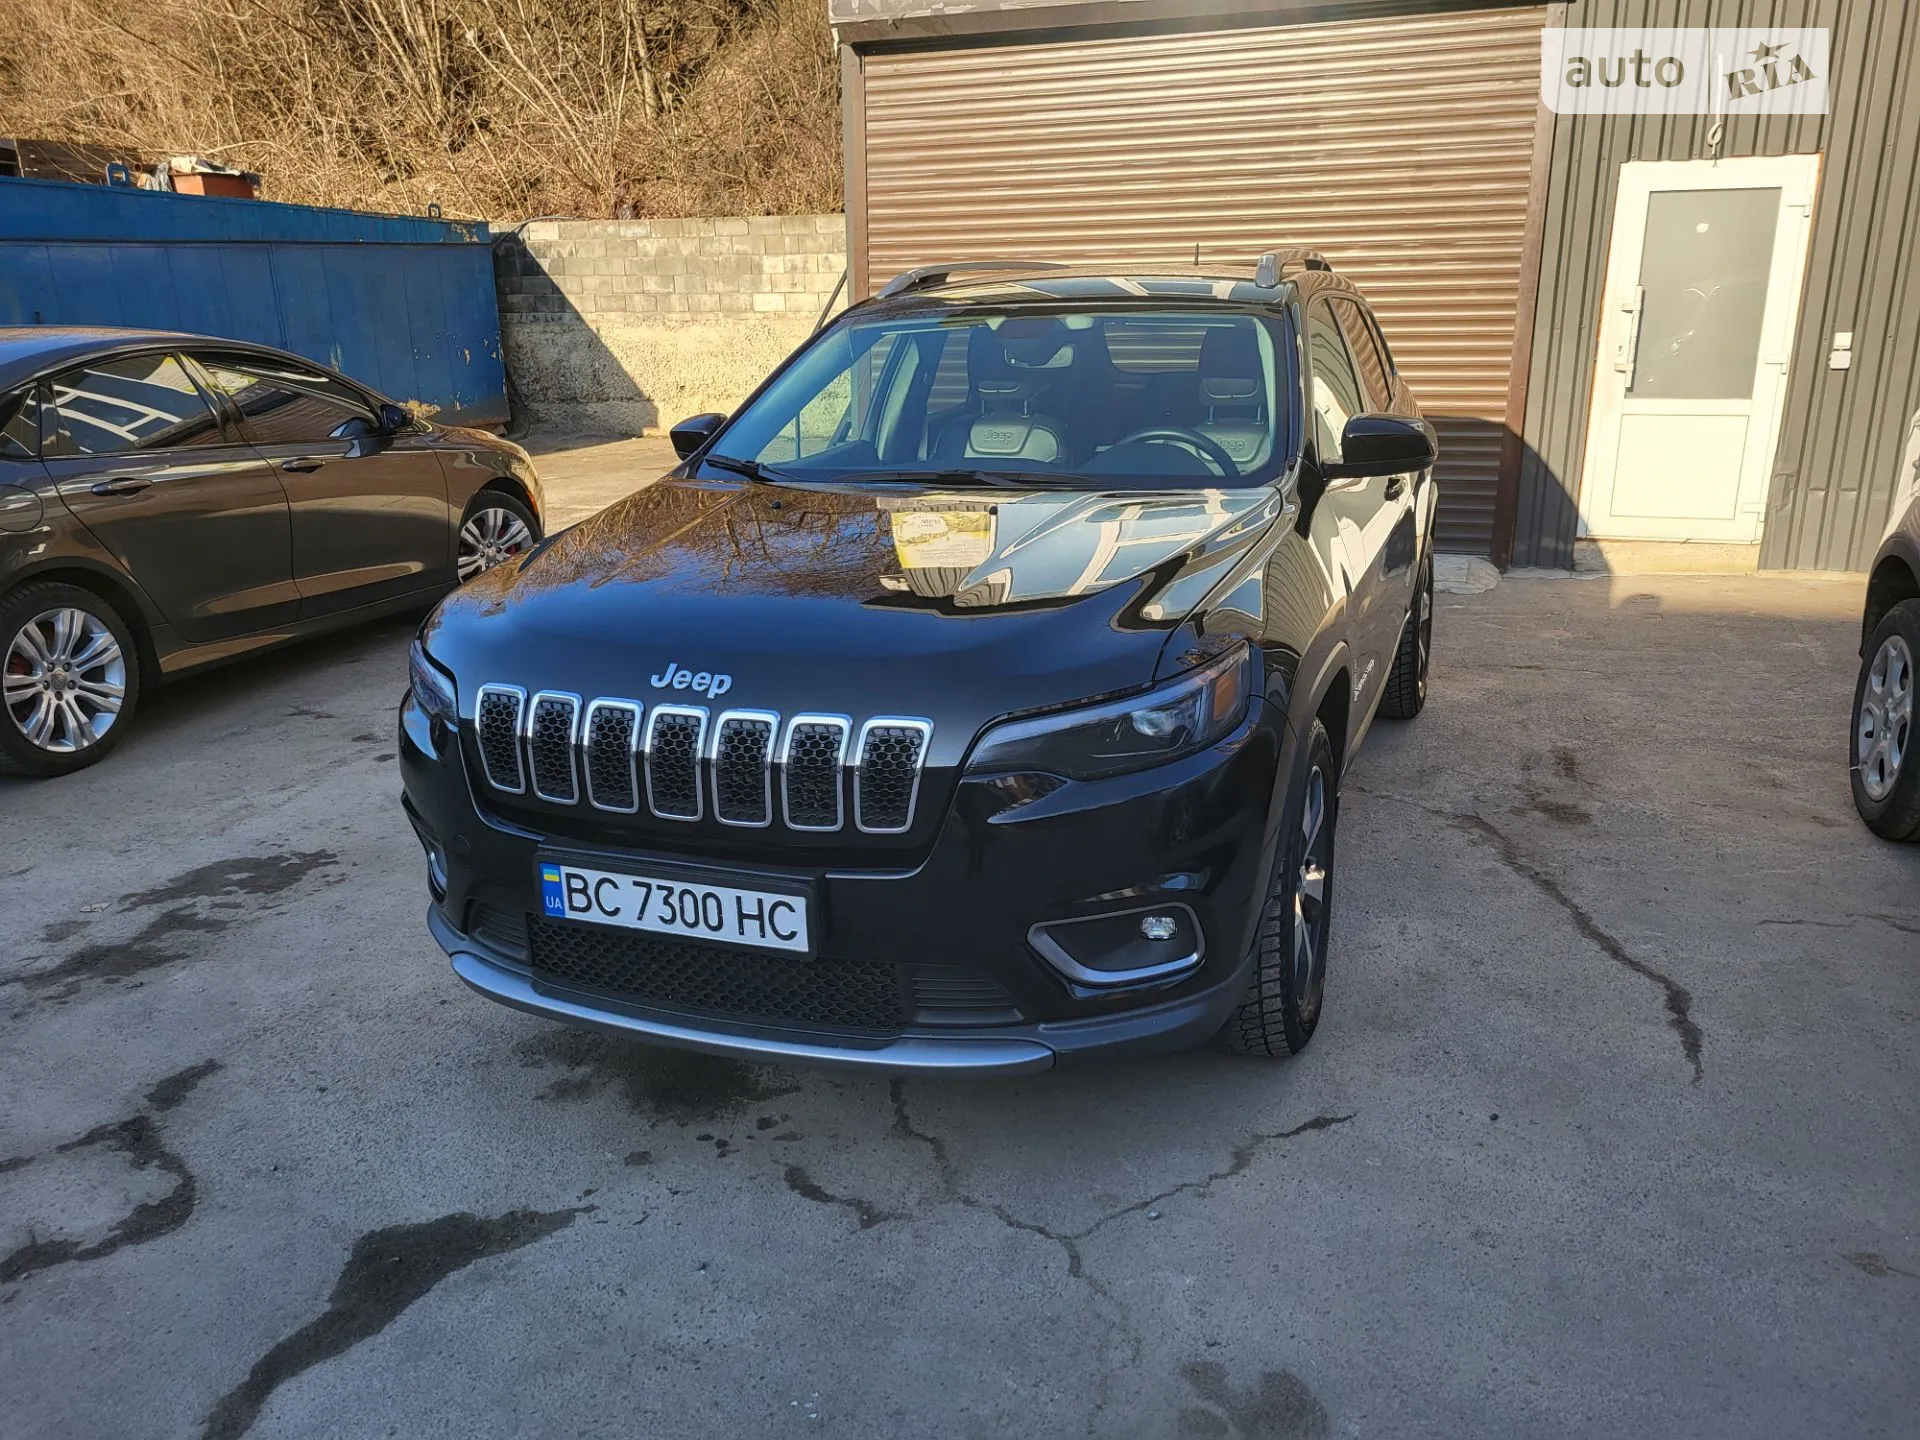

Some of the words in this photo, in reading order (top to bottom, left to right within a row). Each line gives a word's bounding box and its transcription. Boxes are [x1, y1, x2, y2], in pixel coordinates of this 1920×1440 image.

[984, 430, 1013, 444] Jeep
[650, 663, 732, 699] Jeep
[546, 895, 563, 910] UA
[565, 872, 621, 917] BC
[632, 880, 724, 932] 7300
[735, 895, 798, 941] HC
